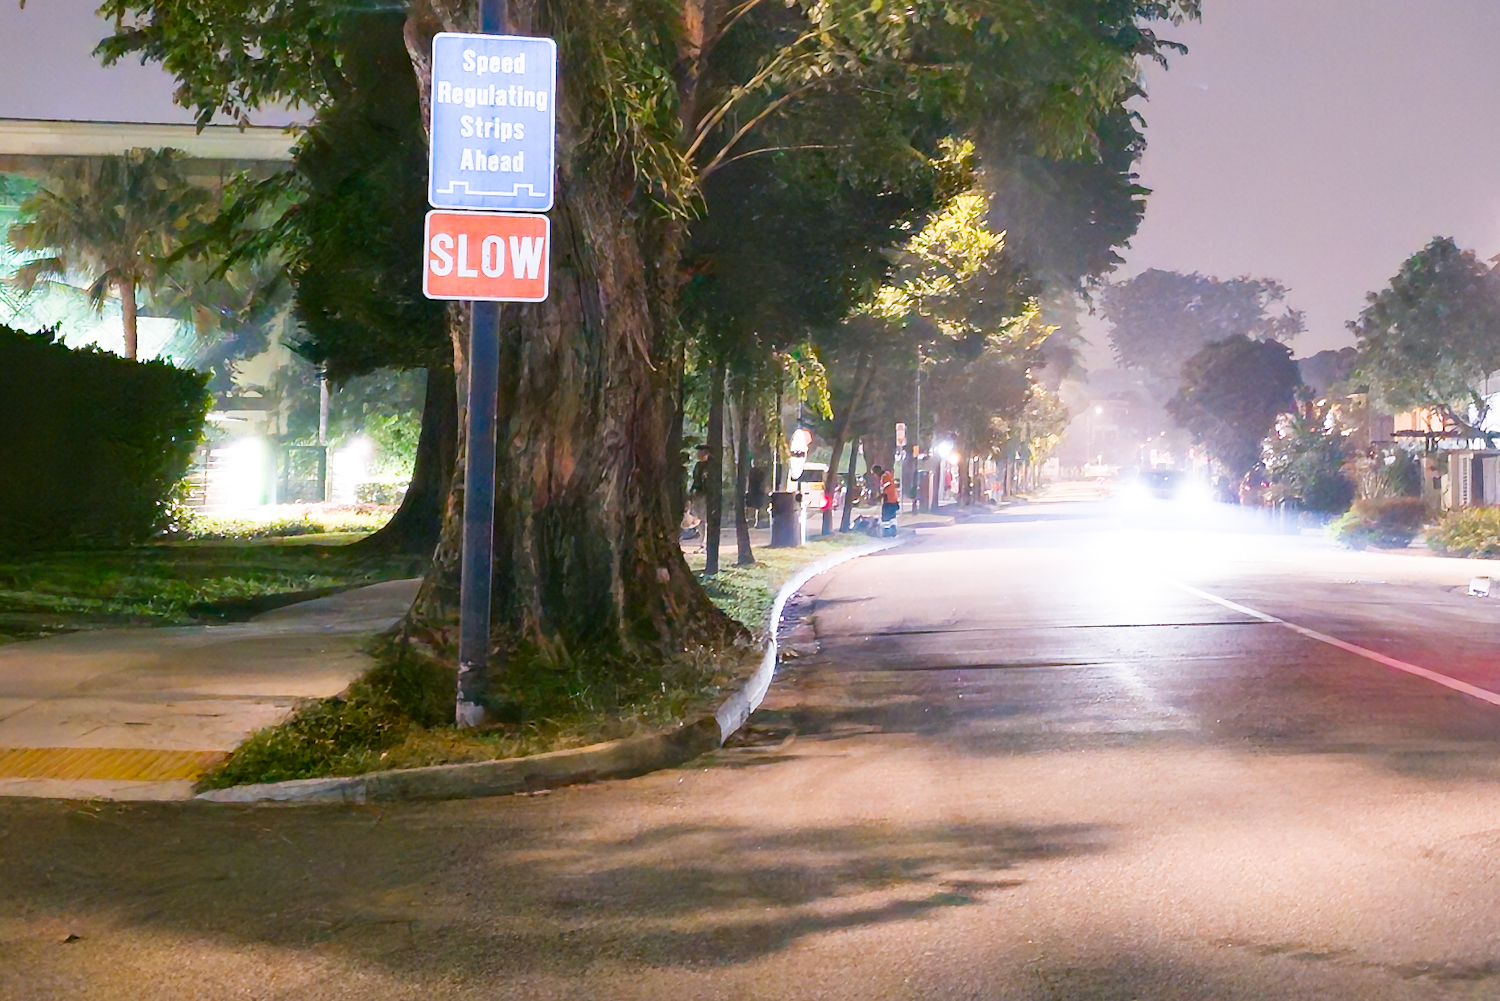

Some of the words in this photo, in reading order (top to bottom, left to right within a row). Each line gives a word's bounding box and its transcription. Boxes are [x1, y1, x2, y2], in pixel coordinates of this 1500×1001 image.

[462, 49, 526, 76] Speed
[437, 81, 548, 112] Regulating
[460, 115, 525, 143] Strips
[460, 148, 524, 172] Ahead
[429, 232, 545, 280] SLOW
